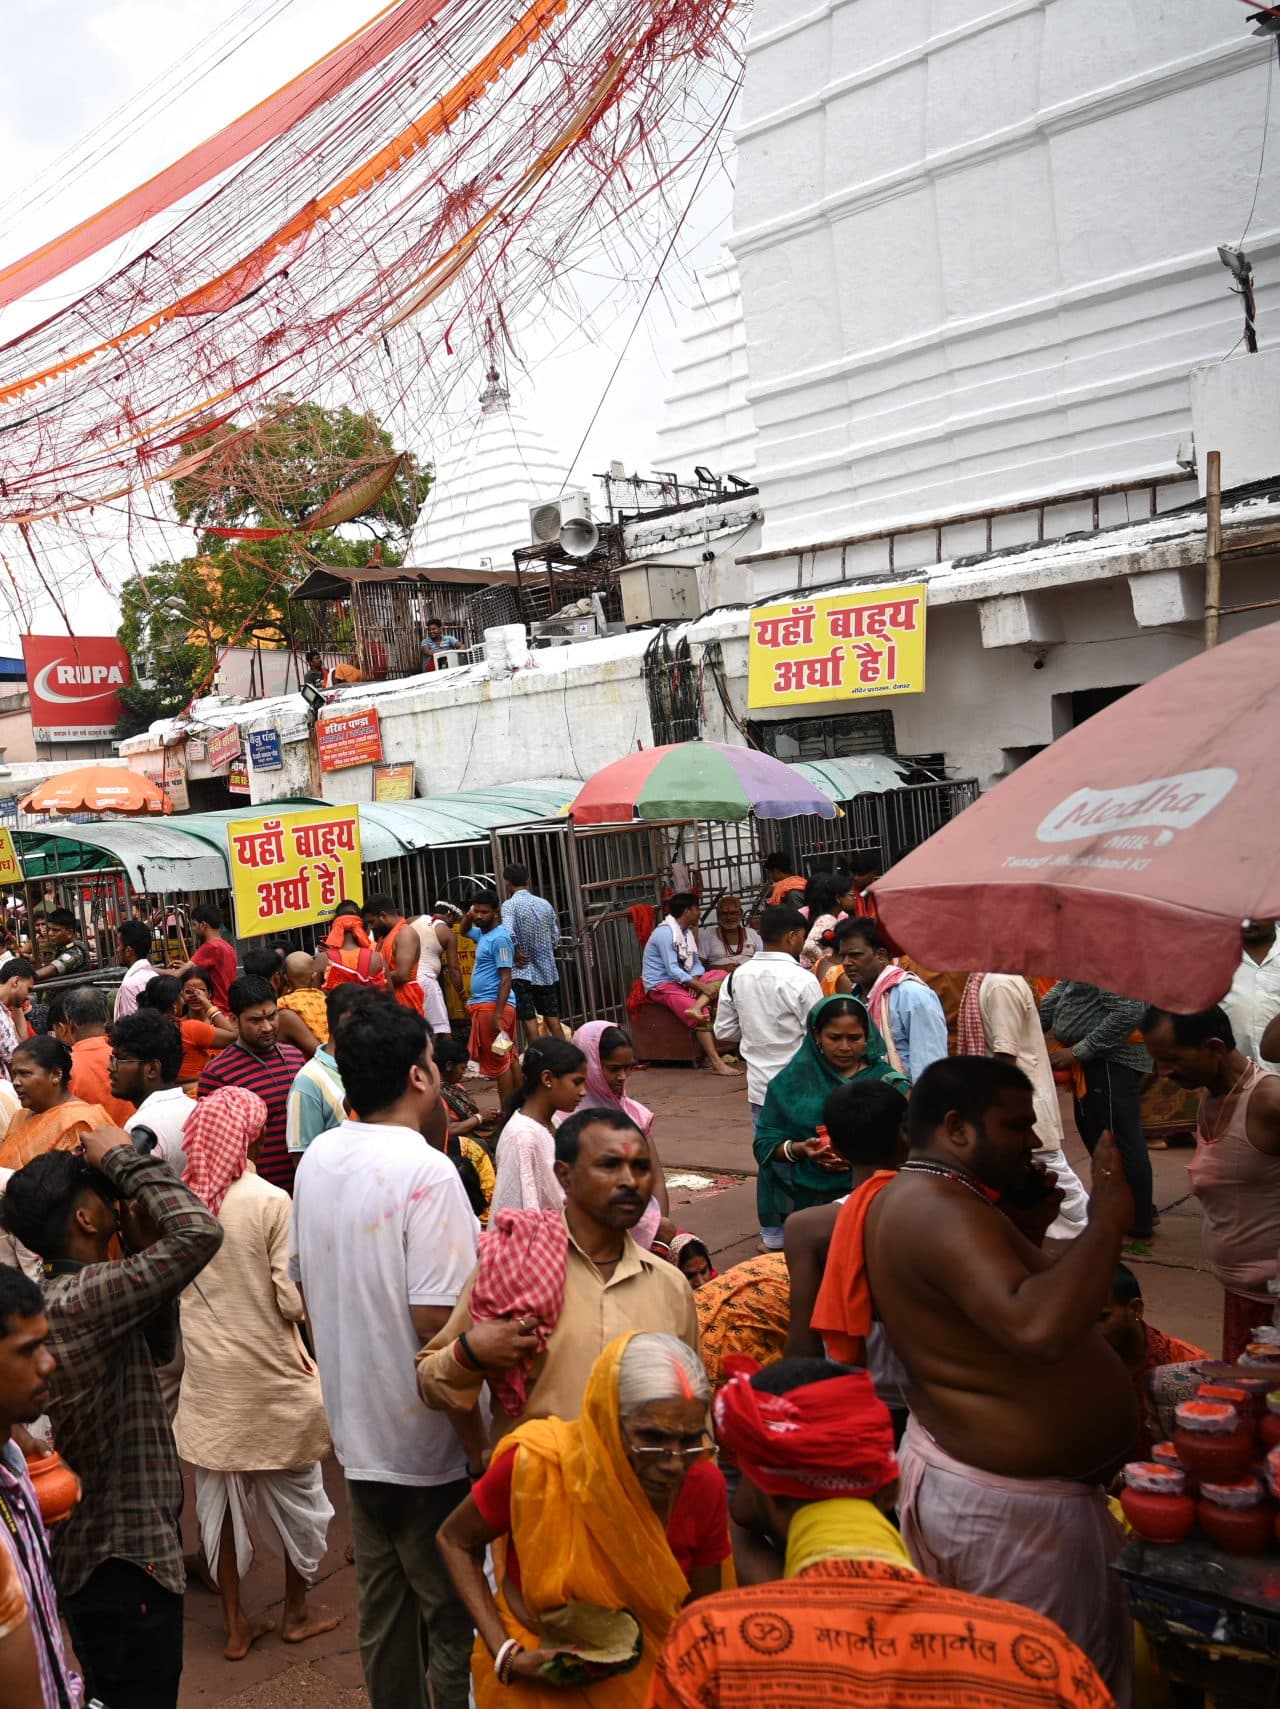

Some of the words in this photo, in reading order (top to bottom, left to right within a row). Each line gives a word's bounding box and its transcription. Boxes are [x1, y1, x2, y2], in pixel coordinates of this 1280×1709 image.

[56, 665, 124, 684] RUPA
[774, 645, 845, 692] अर्घा
[1054, 782, 1206, 830] Medha
[1104, 834, 1149, 850] Milk
[257, 866, 310, 917] अर्घा
